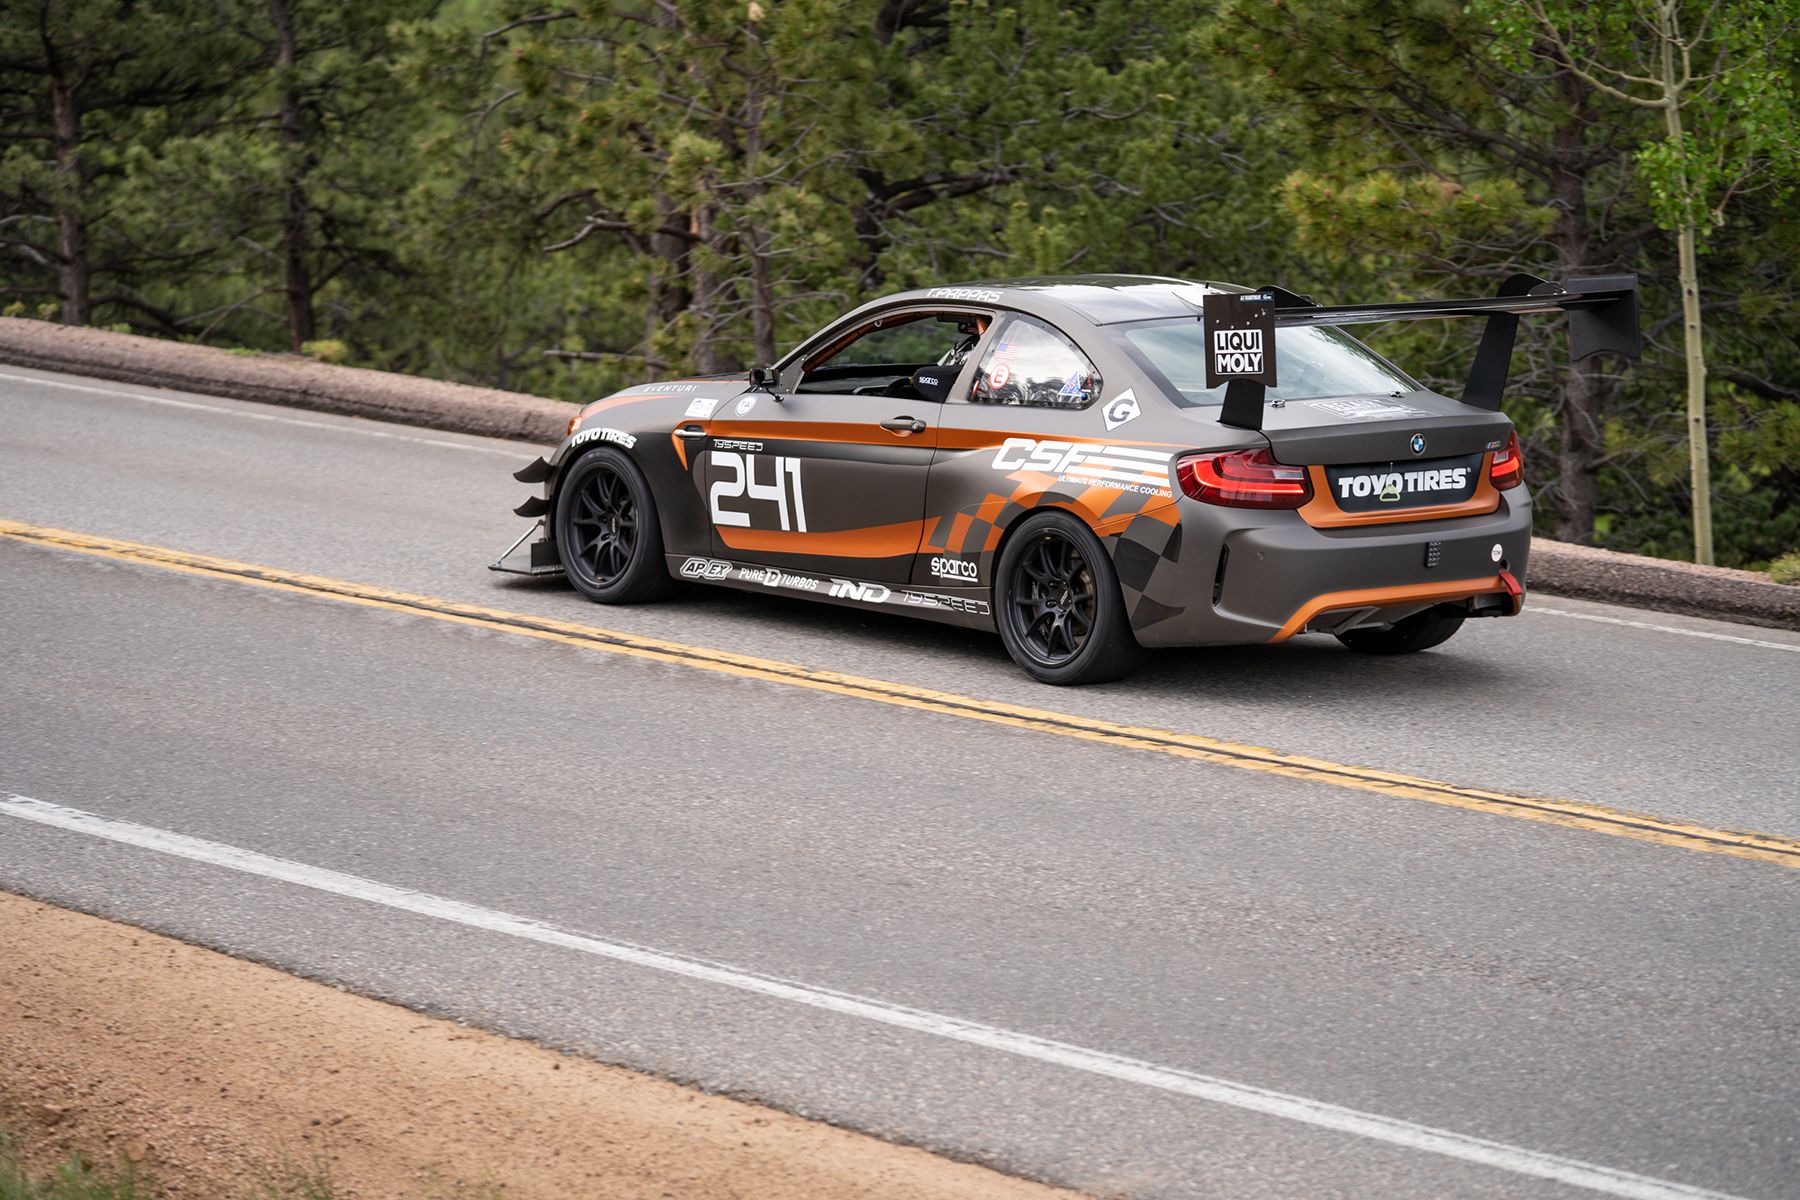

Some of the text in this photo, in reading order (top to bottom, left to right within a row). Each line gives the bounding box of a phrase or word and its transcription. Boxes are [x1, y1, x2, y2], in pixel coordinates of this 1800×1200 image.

[1216, 332, 1260, 351] LIQUI
[1217, 353, 1262, 372] MOLY
[1108, 399, 1134, 422] G
[991, 437, 1106, 473] CSF
[710, 451, 807, 533] 241
[1058, 475, 1173, 499] ULTIMATE PERFORMANCE COOLING
[1338, 472, 1404, 498] TOYO
[738, 567, 766, 581] PURE
[780, 573, 819, 590] TURBOS
[931, 557, 978, 579] sparco
